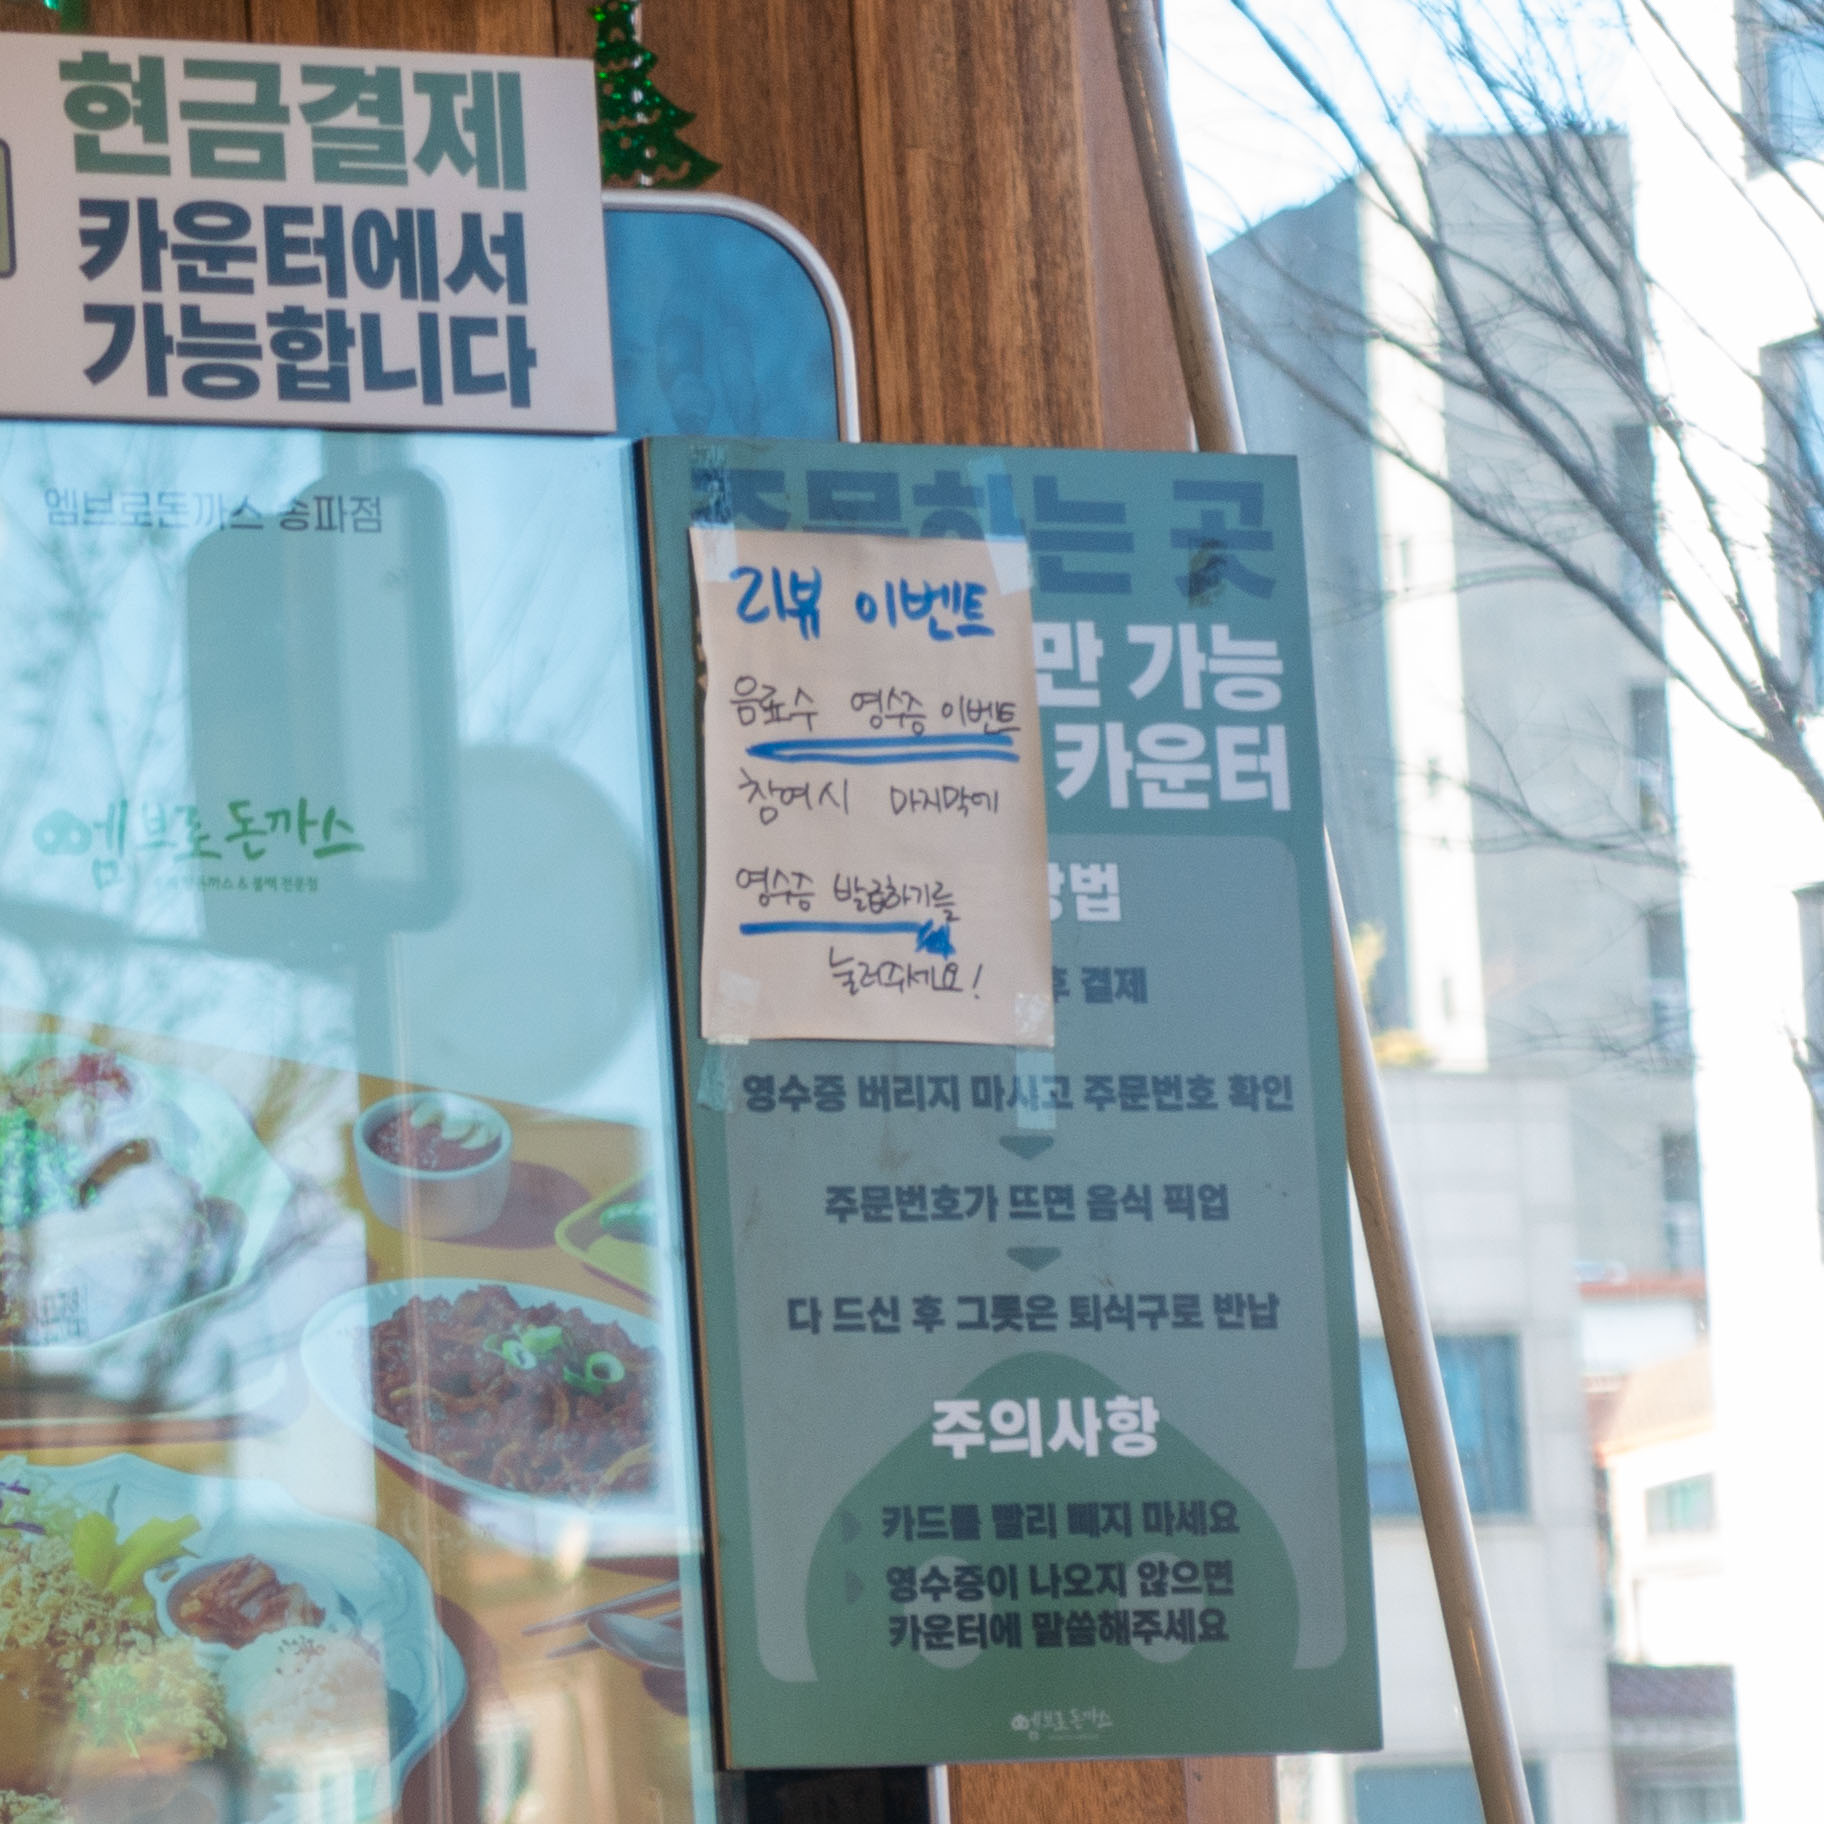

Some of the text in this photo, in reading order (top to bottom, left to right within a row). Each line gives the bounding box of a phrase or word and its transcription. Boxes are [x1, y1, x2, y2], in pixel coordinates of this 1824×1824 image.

[59, 51, 527, 191] 현금결제
[78, 198, 528, 305] 카운터에서
[83, 303, 536, 409] 가능합니다
[44, 486, 384, 536] 엠브로돈까스 송파점
[1170, 480, 1277, 599] 곳
[729, 566, 995, 640] 리뷰 이벤트
[1127, 623, 1284, 712] 가능
[730, 675, 818, 731] 음료수
[851, 686, 926, 737] 영수증
[1055, 721, 1291, 811] 카운터
[890, 785, 999, 818] 마지막에
[736, 867, 815, 911] 영수증
[1081, 966, 1148, 1004] 결제
[742, 1073, 1294, 1113] 영수증 버리지 마시고 주문번호 확인
[826, 1183, 1230, 1223] 주문번호가 뜨면 음식 픽업
[787, 1292, 1281, 1334] 다 드신 후 그릇은 퇴식구로 반납
[931, 1396, 1160, 1459] 주의사항
[881, 1500, 1240, 1542] 카드를 빨리 빼지 마세요
[886, 1559, 1234, 1603] 영수증이 나오지 않으면
[889, 1609, 1229, 1651] 카운터에 말씀해주세요
